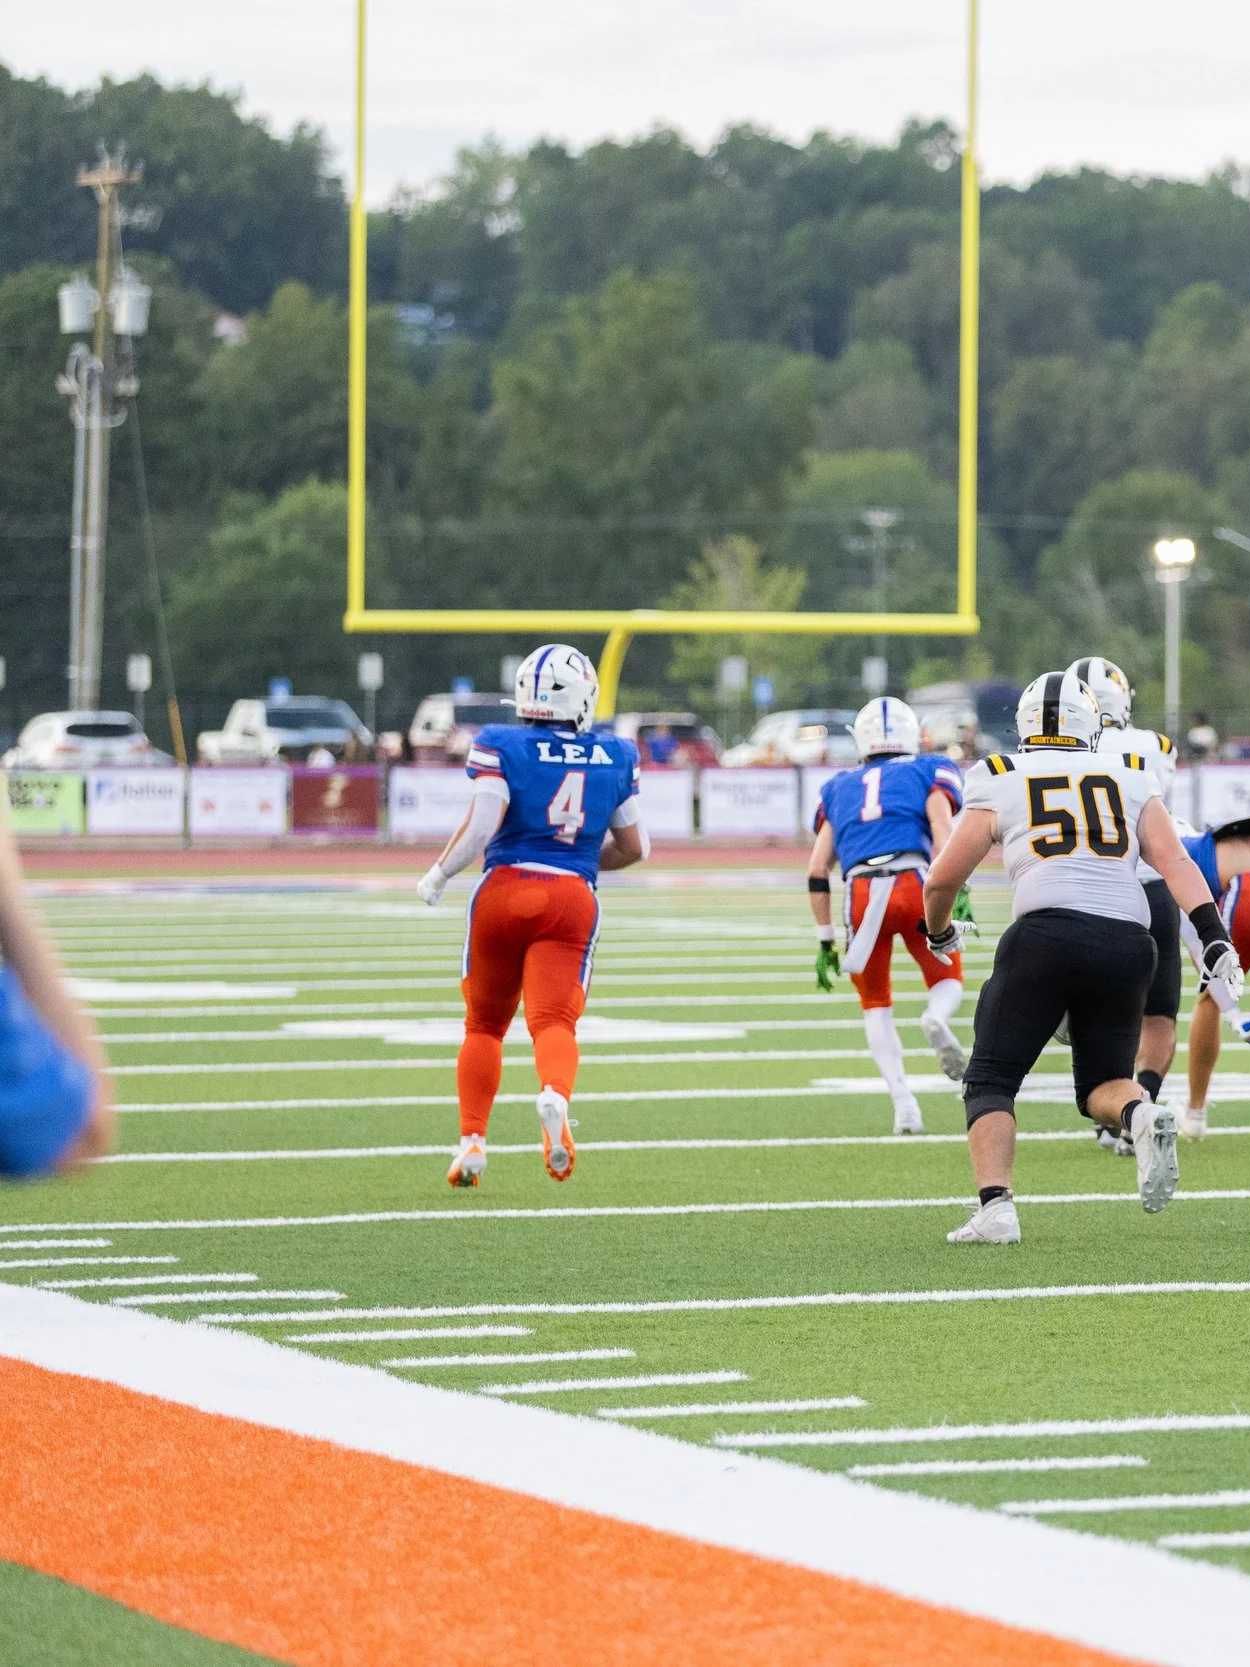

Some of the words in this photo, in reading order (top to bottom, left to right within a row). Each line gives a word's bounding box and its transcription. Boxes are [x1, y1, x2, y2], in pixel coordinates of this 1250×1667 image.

[536, 742, 613, 764] LEA
[1029, 736, 1077, 745] MOUNTAINEERS
[547, 769, 586, 845] 4
[860, 767, 884, 822] 1
[1026, 772, 1129, 859] 50
